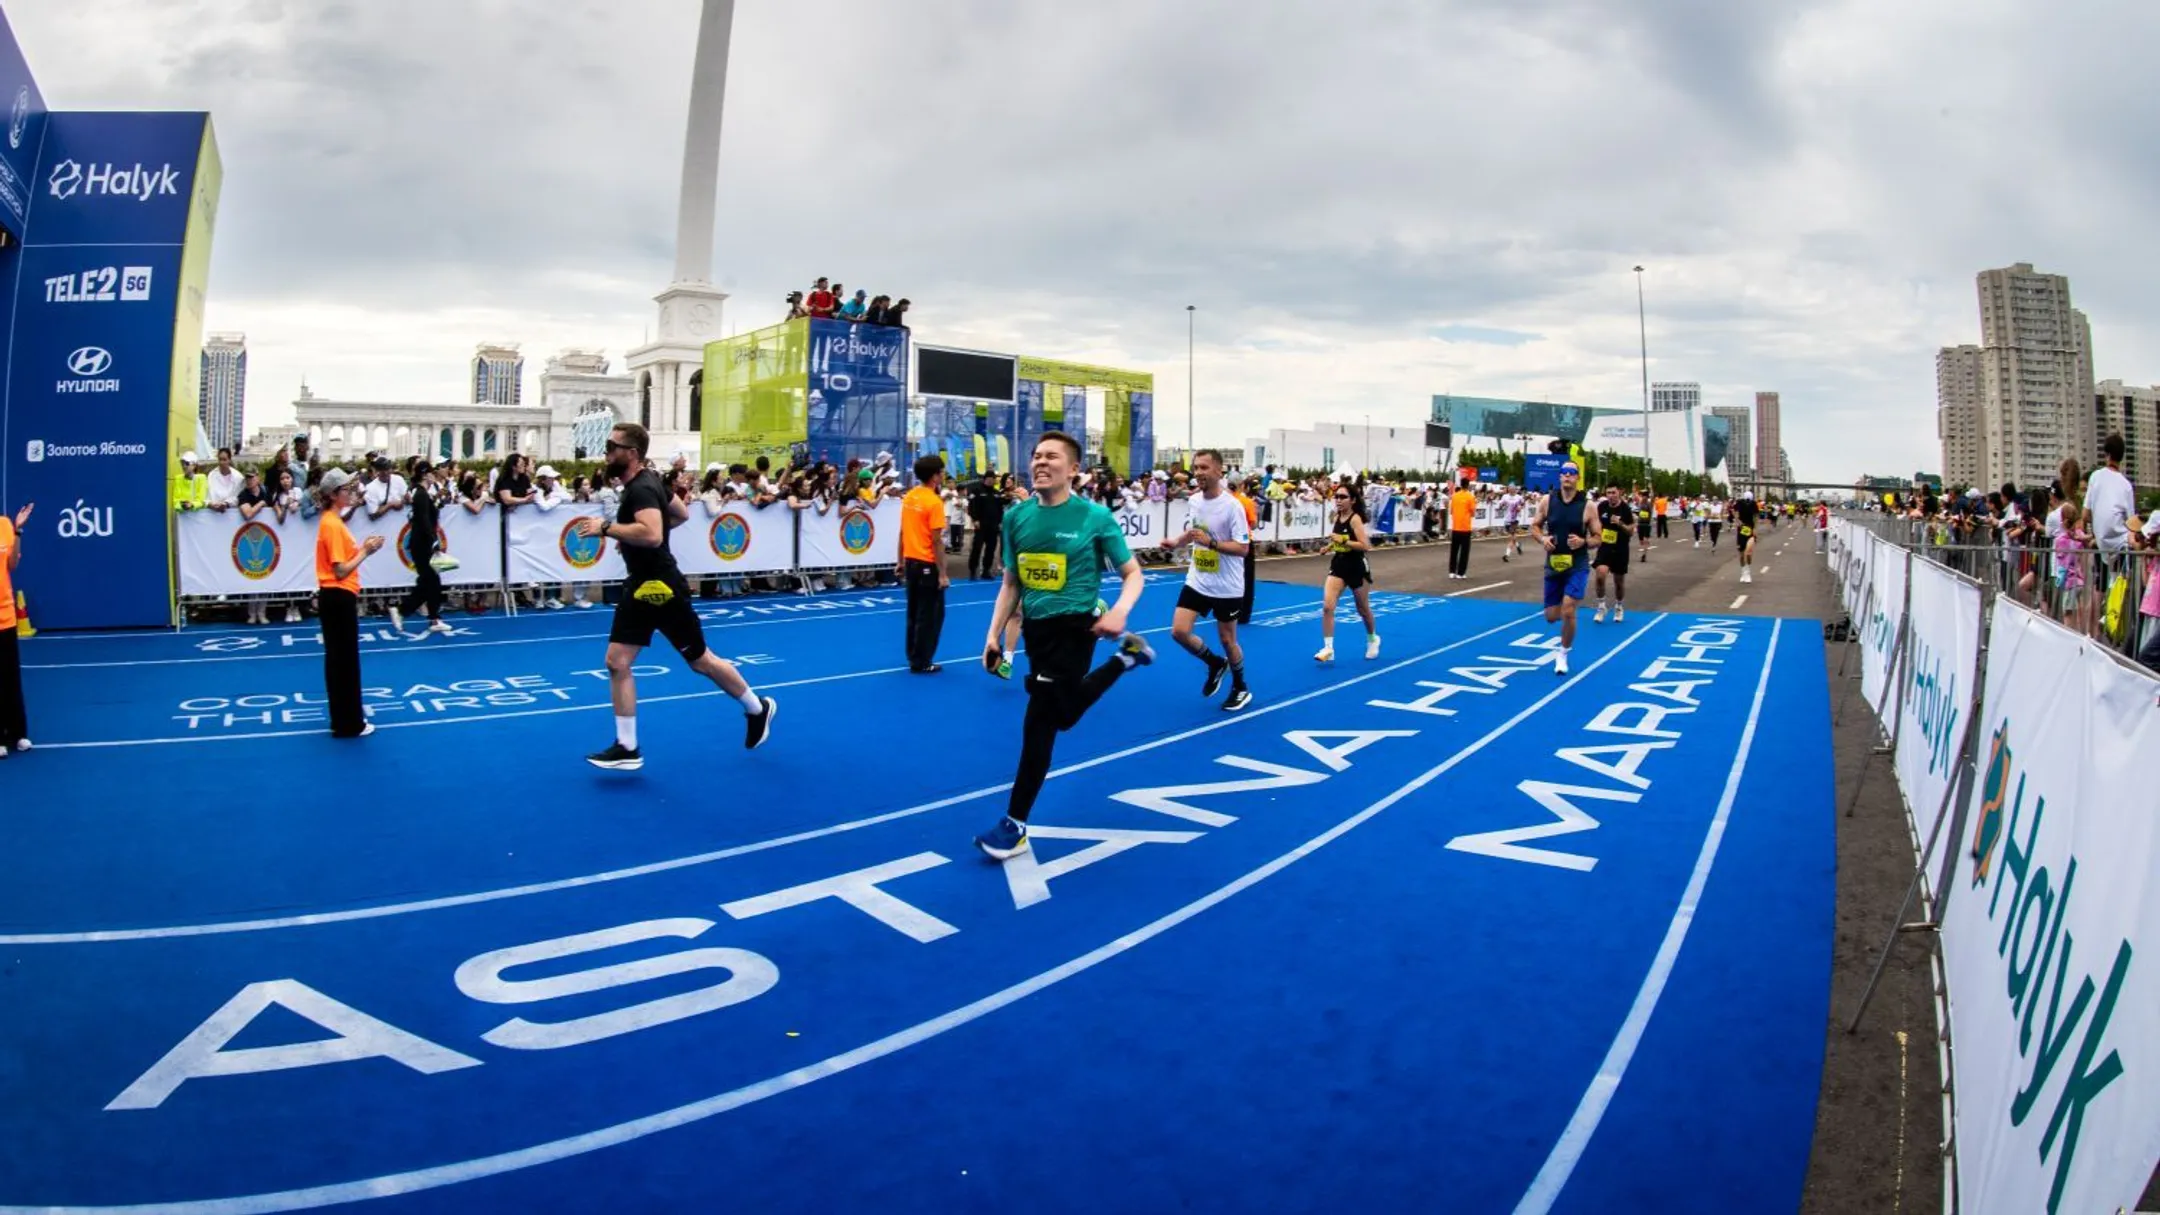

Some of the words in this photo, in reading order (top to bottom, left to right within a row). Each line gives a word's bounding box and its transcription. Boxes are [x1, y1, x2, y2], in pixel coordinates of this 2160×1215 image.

[85, 163, 180, 201] Halyk
[45, 266, 117, 302] TELE2
[56, 379, 120, 393] HYUNDAI
[47, 443, 97, 456] Золотое
[100, 440, 146, 455] Яблоко
[1025, 567, 1058, 580] 7554
[171, 708, 327, 729] THE
[1912, 636, 1958, 783] Halyk
[1445, 618, 1746, 872] MARATHON
[105, 729, 1421, 1109] ASTANA
[1365, 633, 1570, 717] HALF
[1988, 770, 2133, 1215] Halyk
